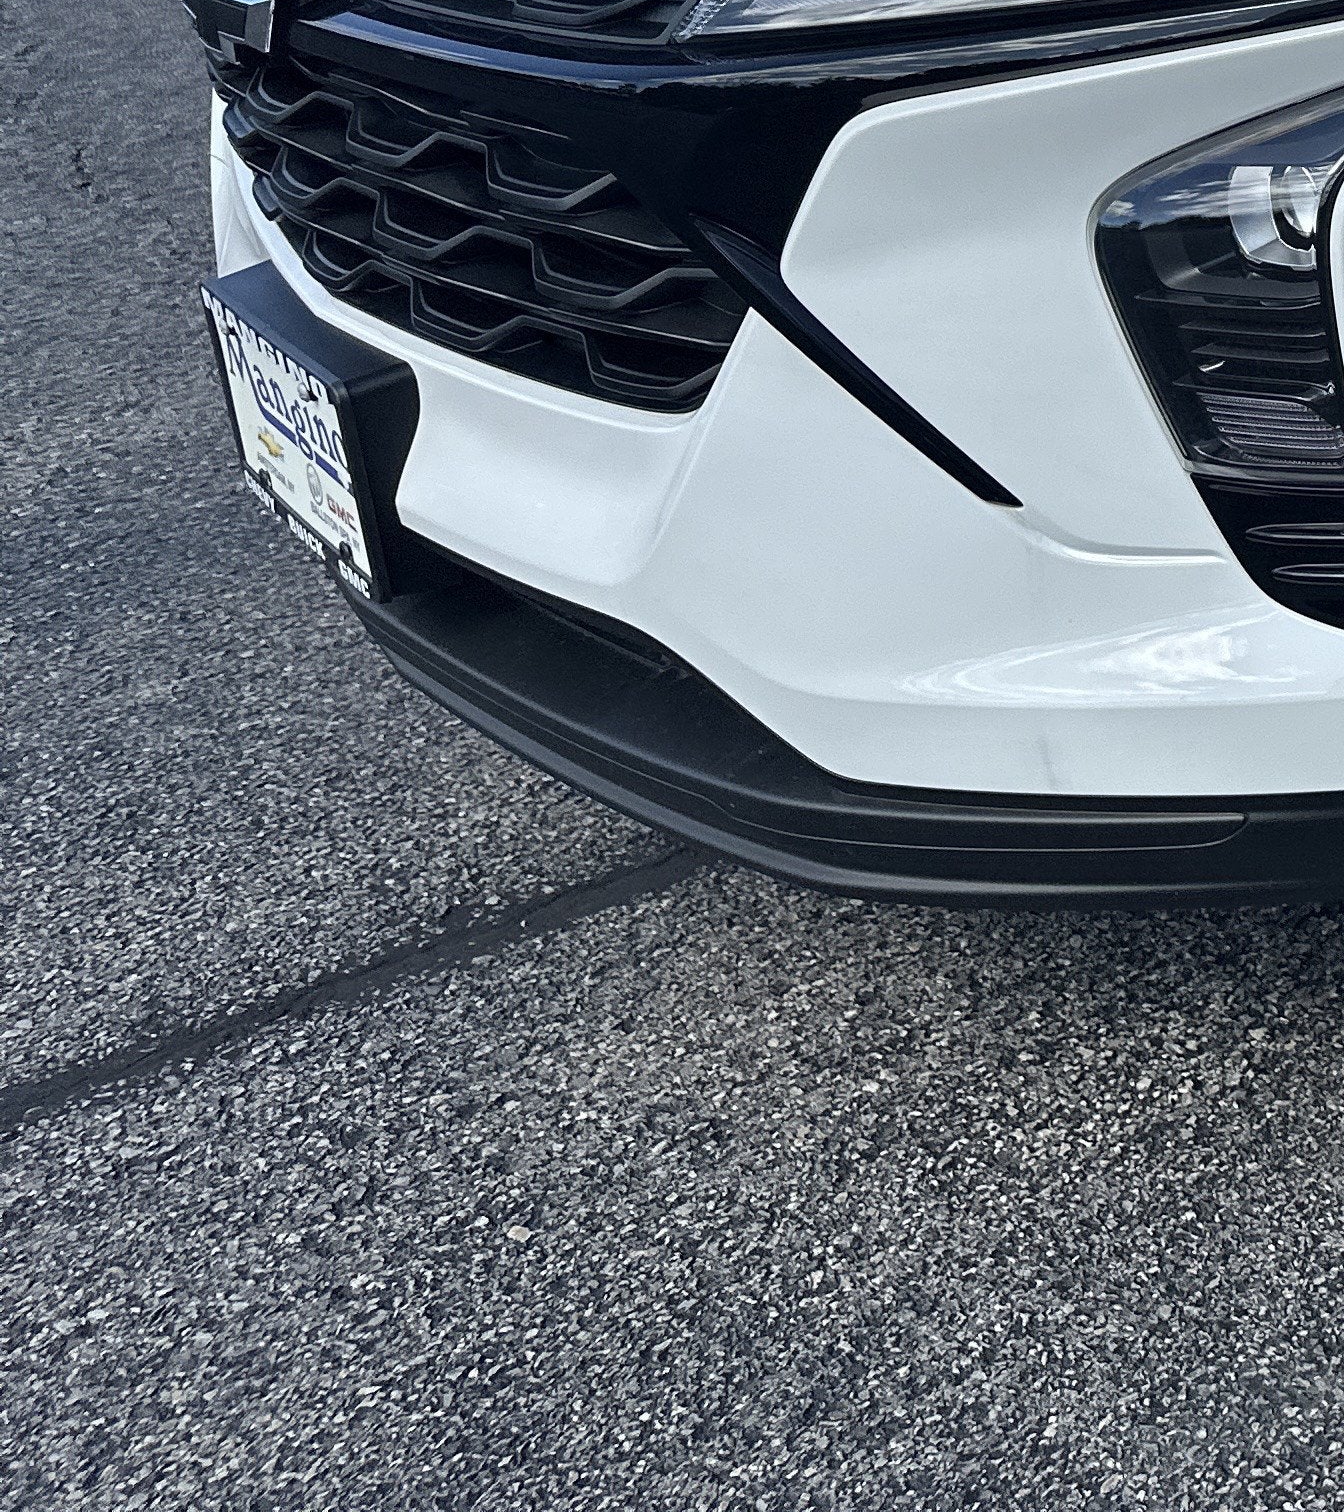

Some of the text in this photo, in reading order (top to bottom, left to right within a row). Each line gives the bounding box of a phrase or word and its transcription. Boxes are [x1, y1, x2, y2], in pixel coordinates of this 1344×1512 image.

[226, 331, 348, 469] Mangino
[244, 469, 276, 514] CHEVY
[287, 514, 326, 562] BUICK
[338, 559, 371, 599] GMC
